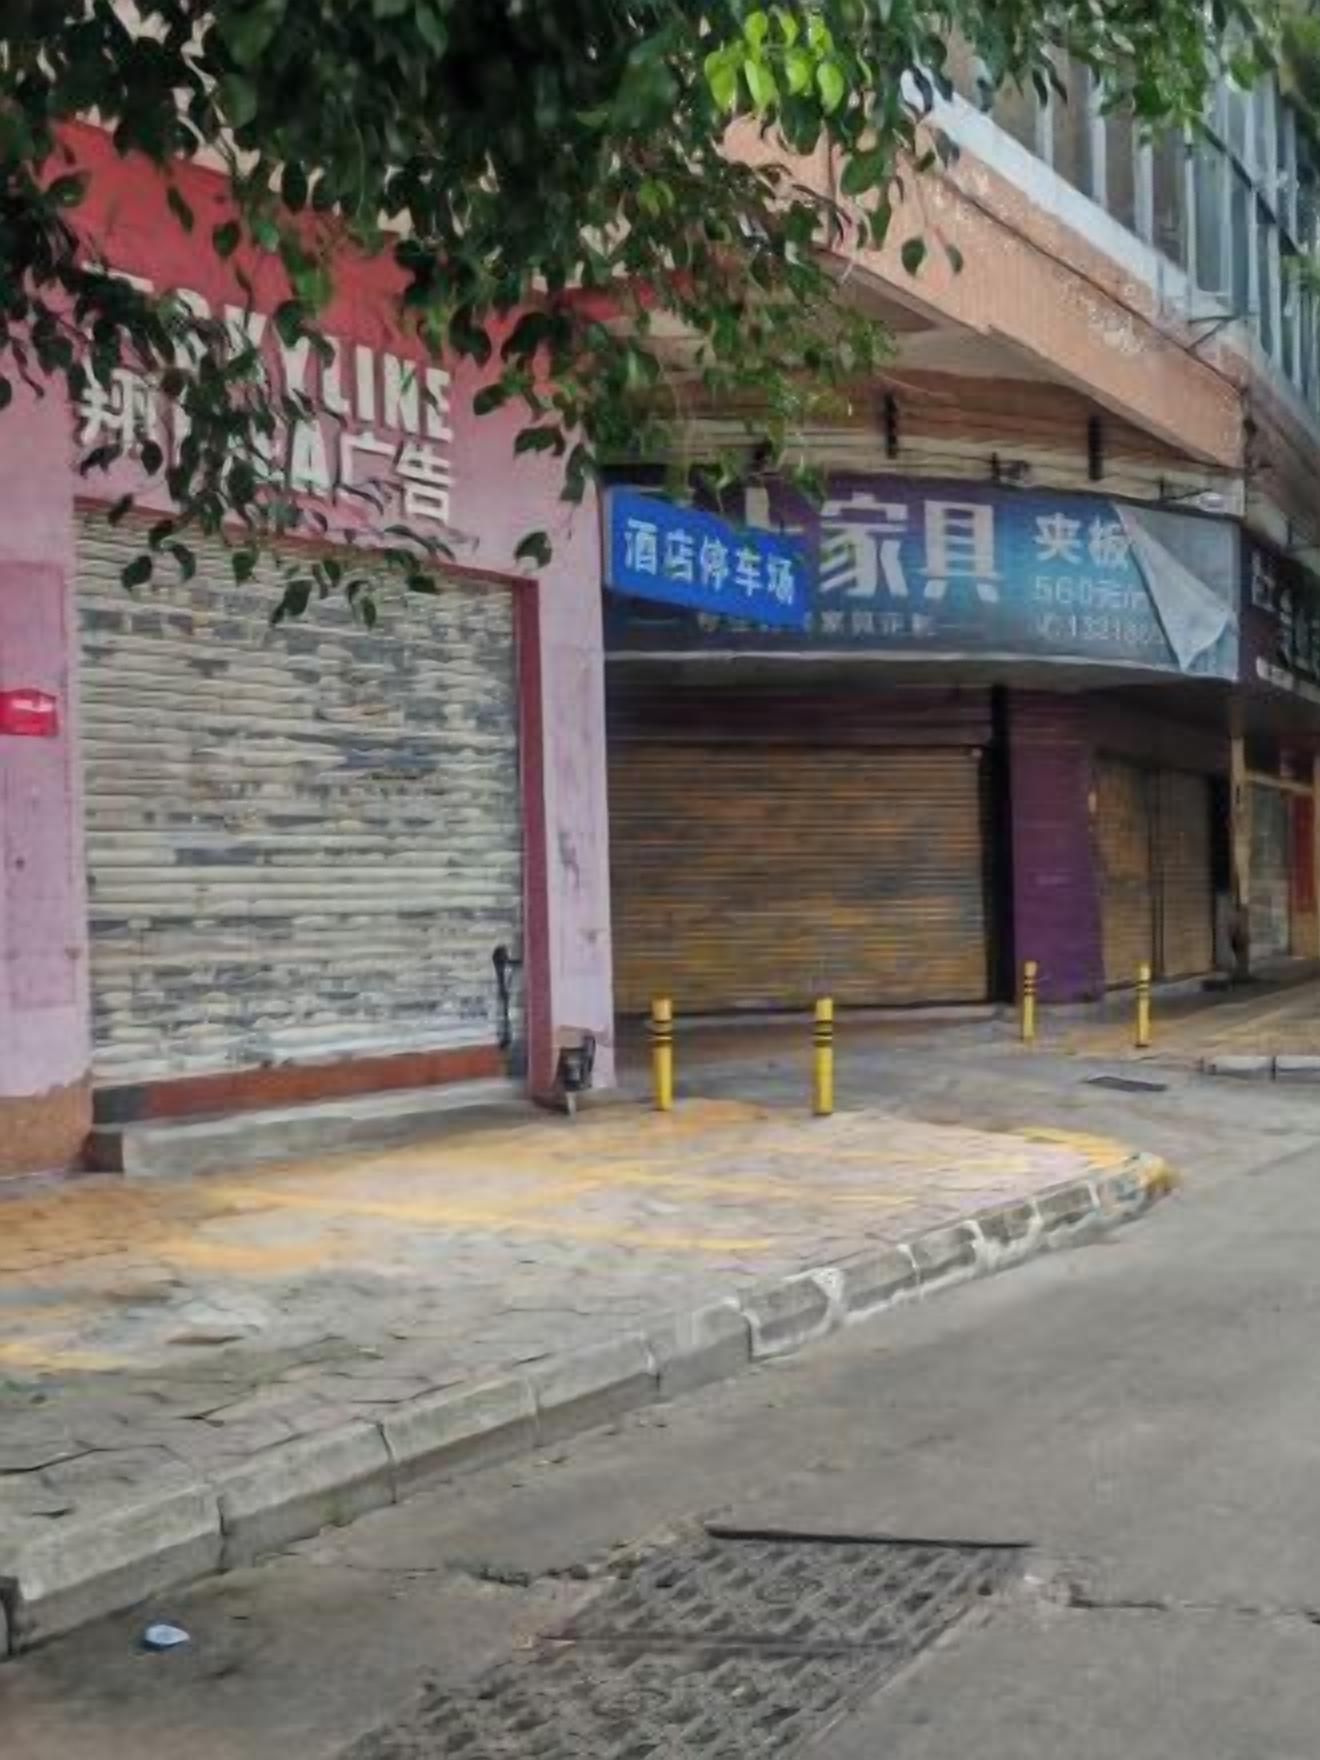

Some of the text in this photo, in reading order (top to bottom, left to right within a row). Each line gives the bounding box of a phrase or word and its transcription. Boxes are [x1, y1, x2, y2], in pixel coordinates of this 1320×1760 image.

[622, 517, 795, 606] 酒店停车场
